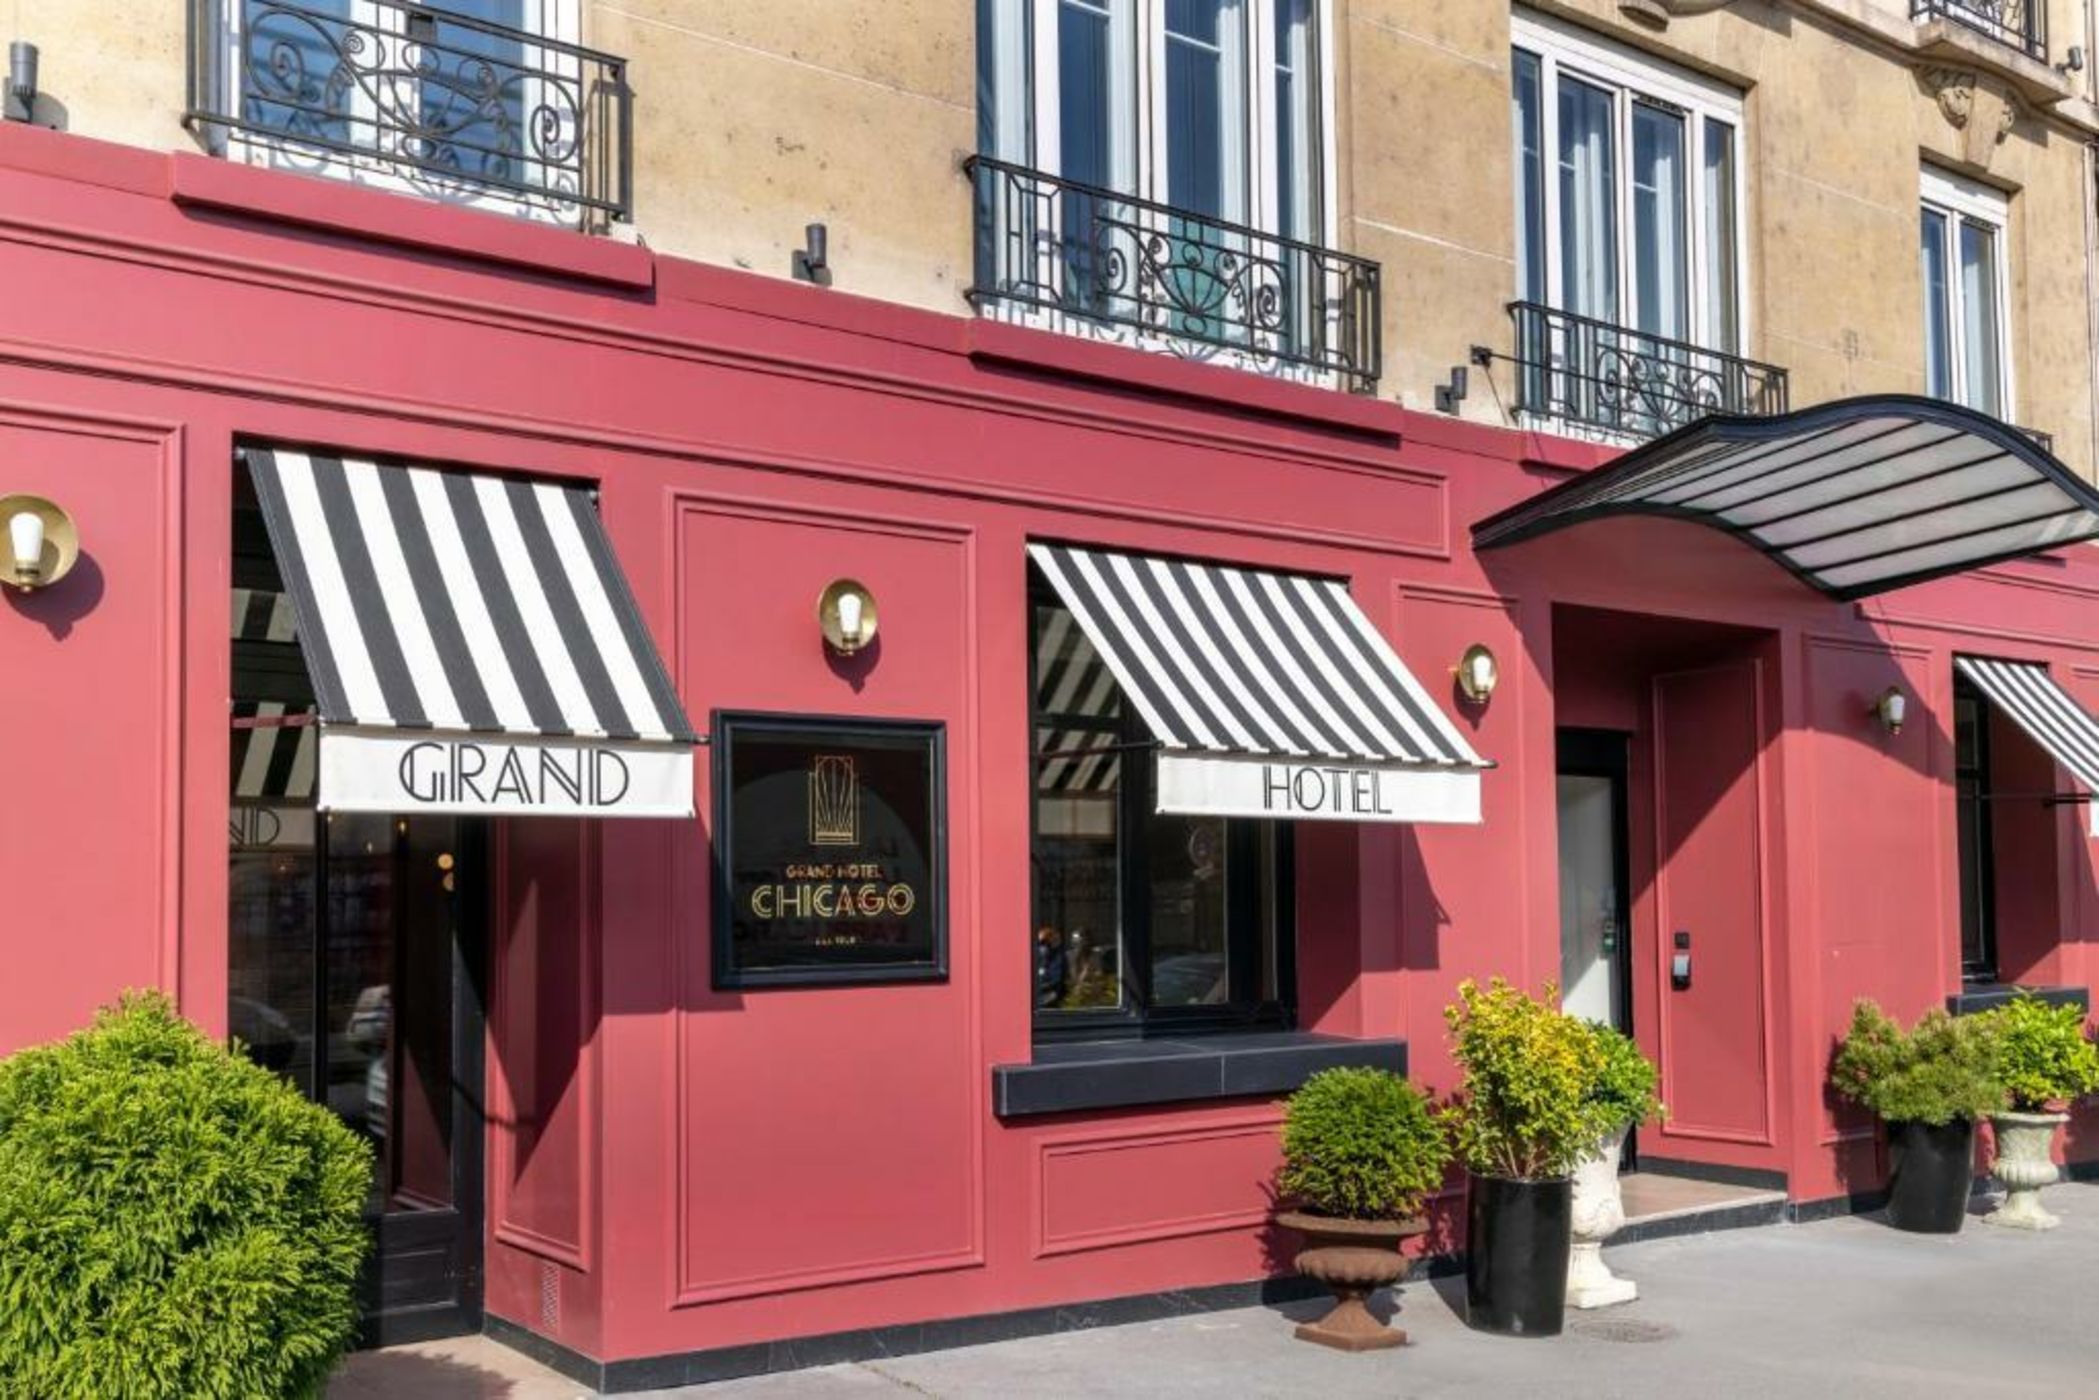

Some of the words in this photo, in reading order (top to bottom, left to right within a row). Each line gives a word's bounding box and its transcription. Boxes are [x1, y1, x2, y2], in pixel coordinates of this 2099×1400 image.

[399, 741, 629, 806] GRAND
[1262, 765, 1393, 812] HOTEL
[786, 864, 833, 878] GRAND
[838, 864, 882, 878] HOTEL
[751, 883, 915, 919] CHICAGO
